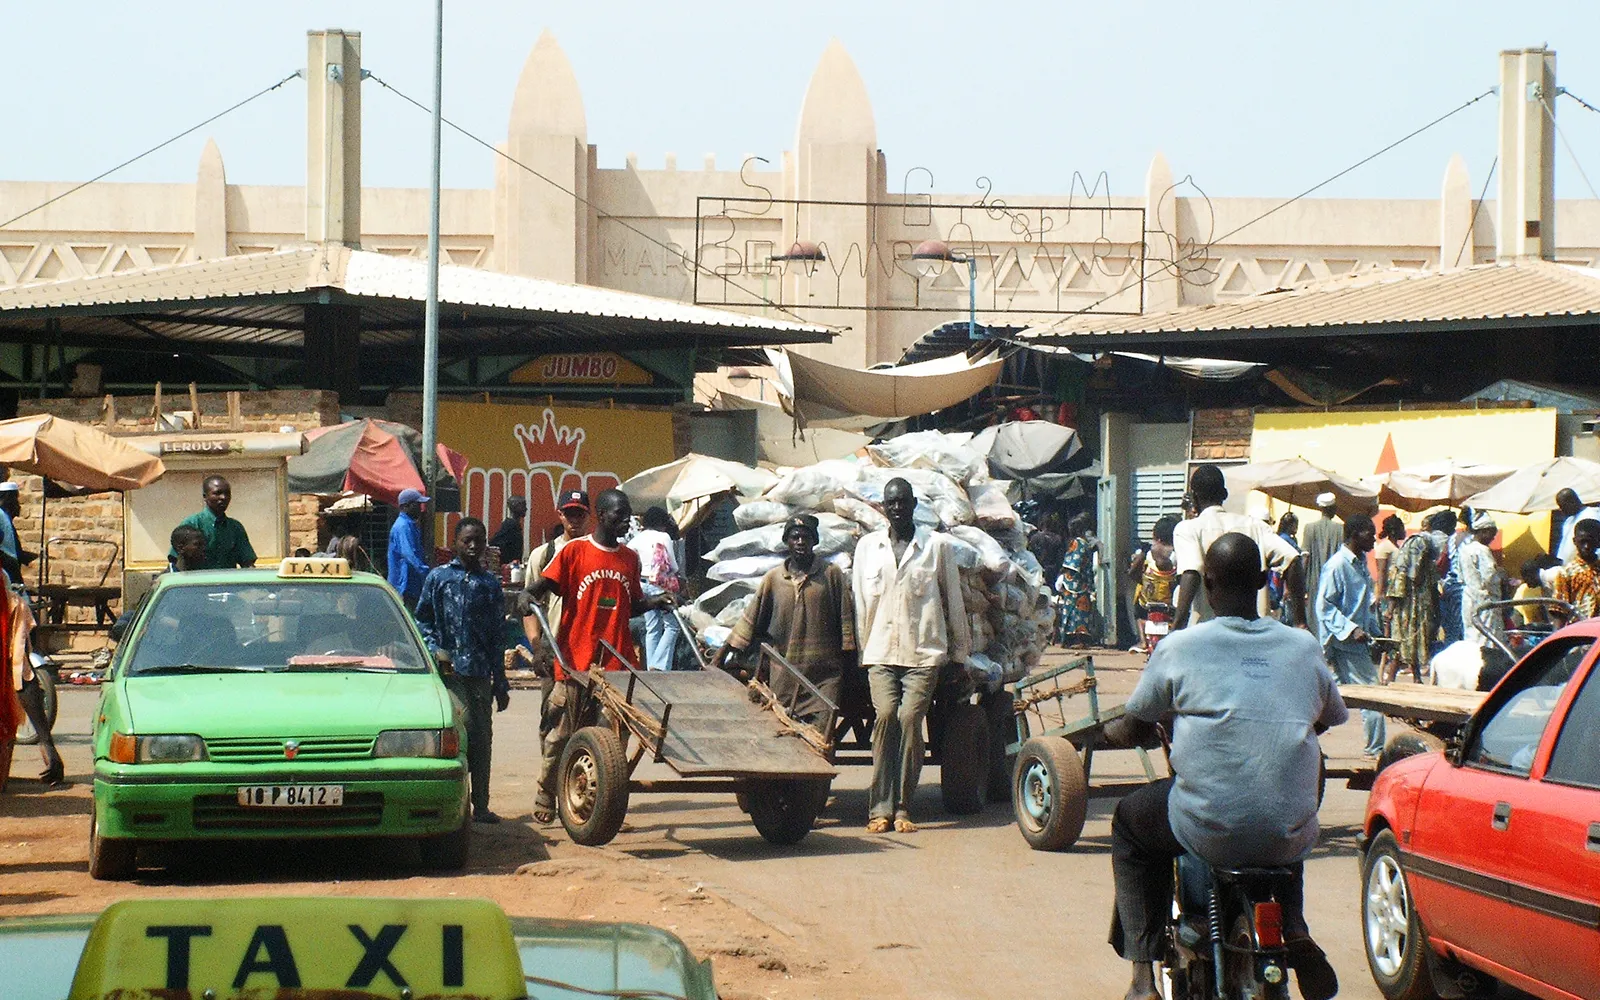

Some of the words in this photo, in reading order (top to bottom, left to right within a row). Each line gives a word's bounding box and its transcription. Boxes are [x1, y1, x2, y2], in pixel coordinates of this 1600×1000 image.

[542, 356, 617, 378] JUMBO
[163, 441, 223, 452] LEROUX
[289, 562, 340, 575] TAXI
[271, 787, 281, 805] P
[287, 787, 327, 805] 8412
[145, 924, 465, 988] TAXI
